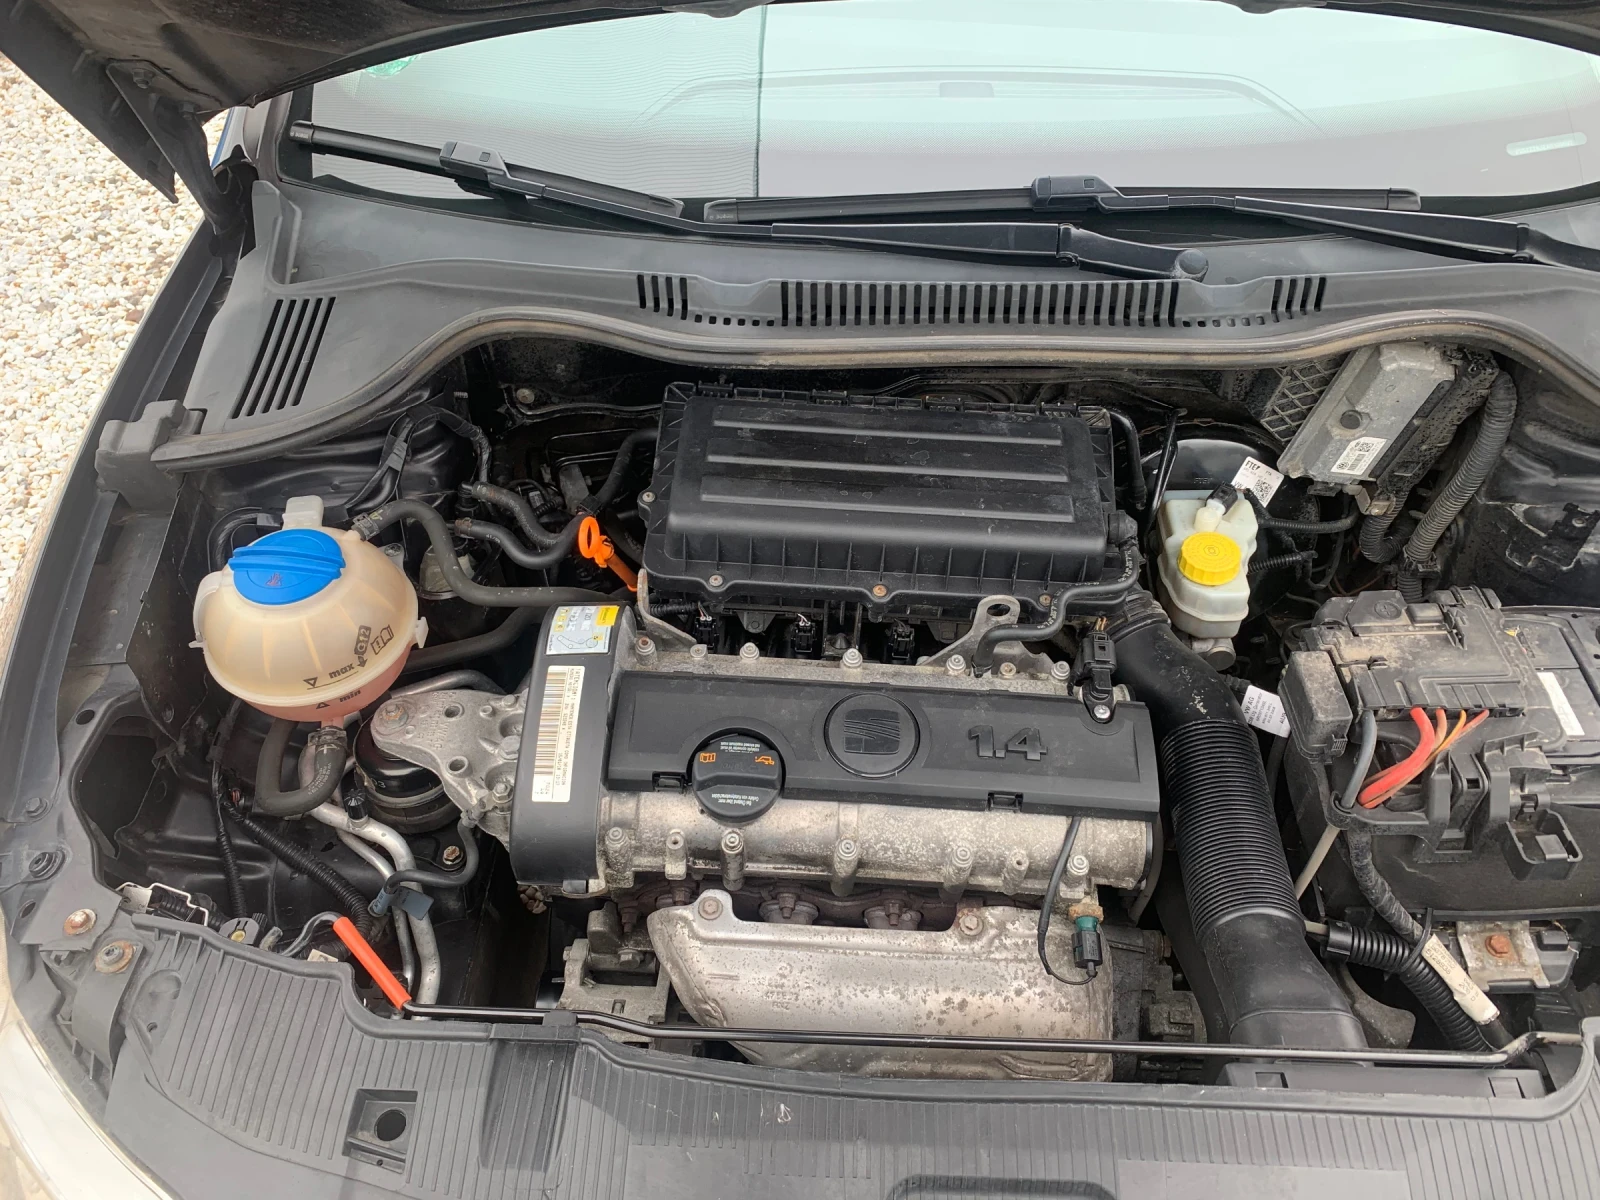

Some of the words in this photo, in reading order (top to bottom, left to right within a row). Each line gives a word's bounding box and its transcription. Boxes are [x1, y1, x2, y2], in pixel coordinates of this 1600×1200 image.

[329, 663, 355, 679] max
[340, 690, 361, 702] min
[968, 725, 1048, 761] 1.4
